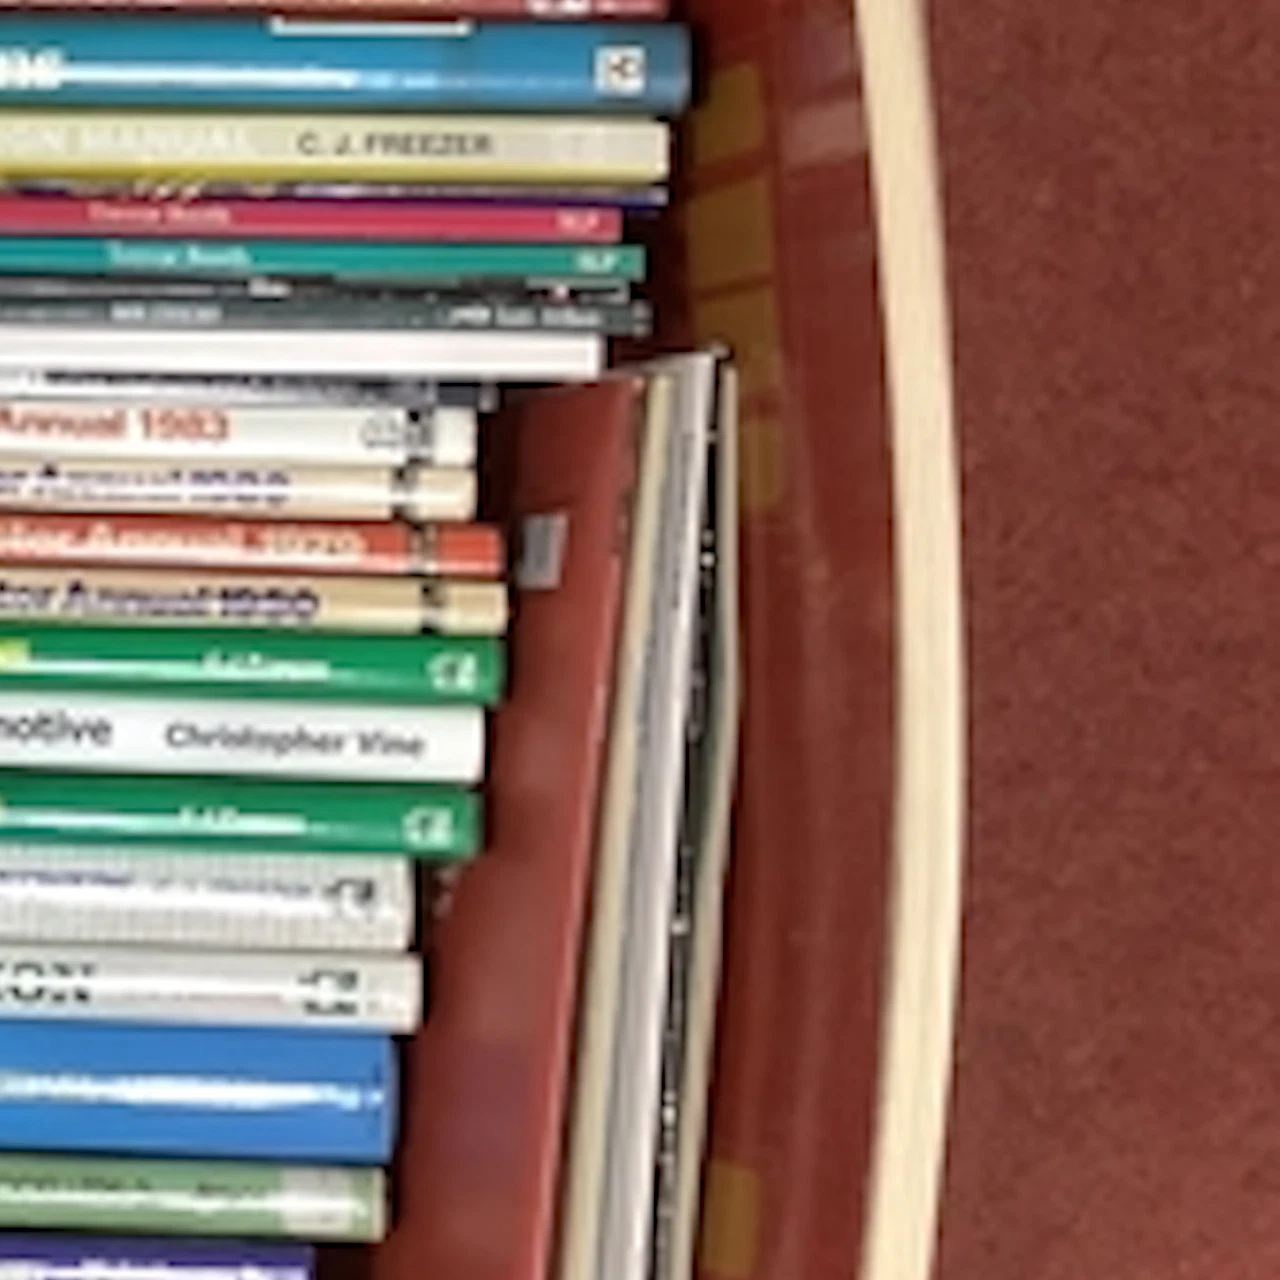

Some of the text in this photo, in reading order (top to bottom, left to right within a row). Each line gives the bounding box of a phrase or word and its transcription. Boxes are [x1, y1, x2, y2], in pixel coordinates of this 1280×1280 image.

[364, 134, 494, 155] FREEZER
[165, 722, 426, 757] Christopher Vine
